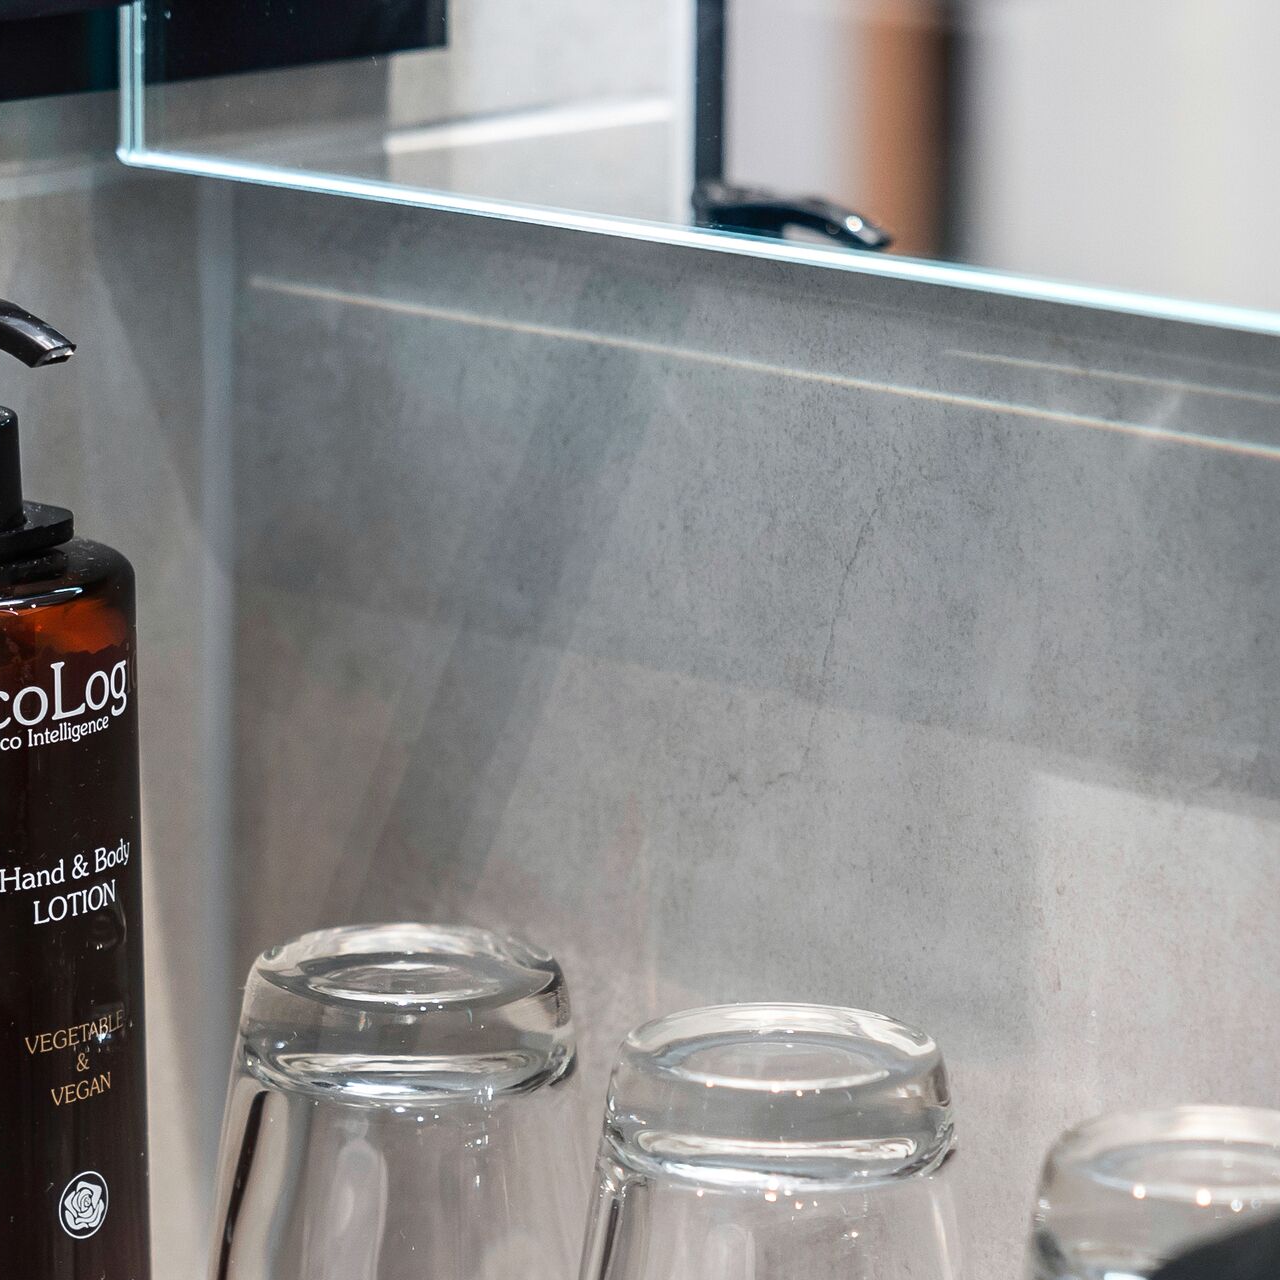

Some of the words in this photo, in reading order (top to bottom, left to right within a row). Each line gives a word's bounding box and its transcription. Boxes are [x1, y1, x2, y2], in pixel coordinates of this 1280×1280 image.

[27, 715, 109, 748] Intelligence
[0, 858, 66, 893] Hand
[71, 853, 90, 880] &
[94, 837, 131, 873] Body
[33, 878, 117, 925] LOTION
[24, 1009, 125, 1055] VEGETABLE
[76, 1052, 91, 1073] &
[51, 1071, 112, 1107] VEGAN
